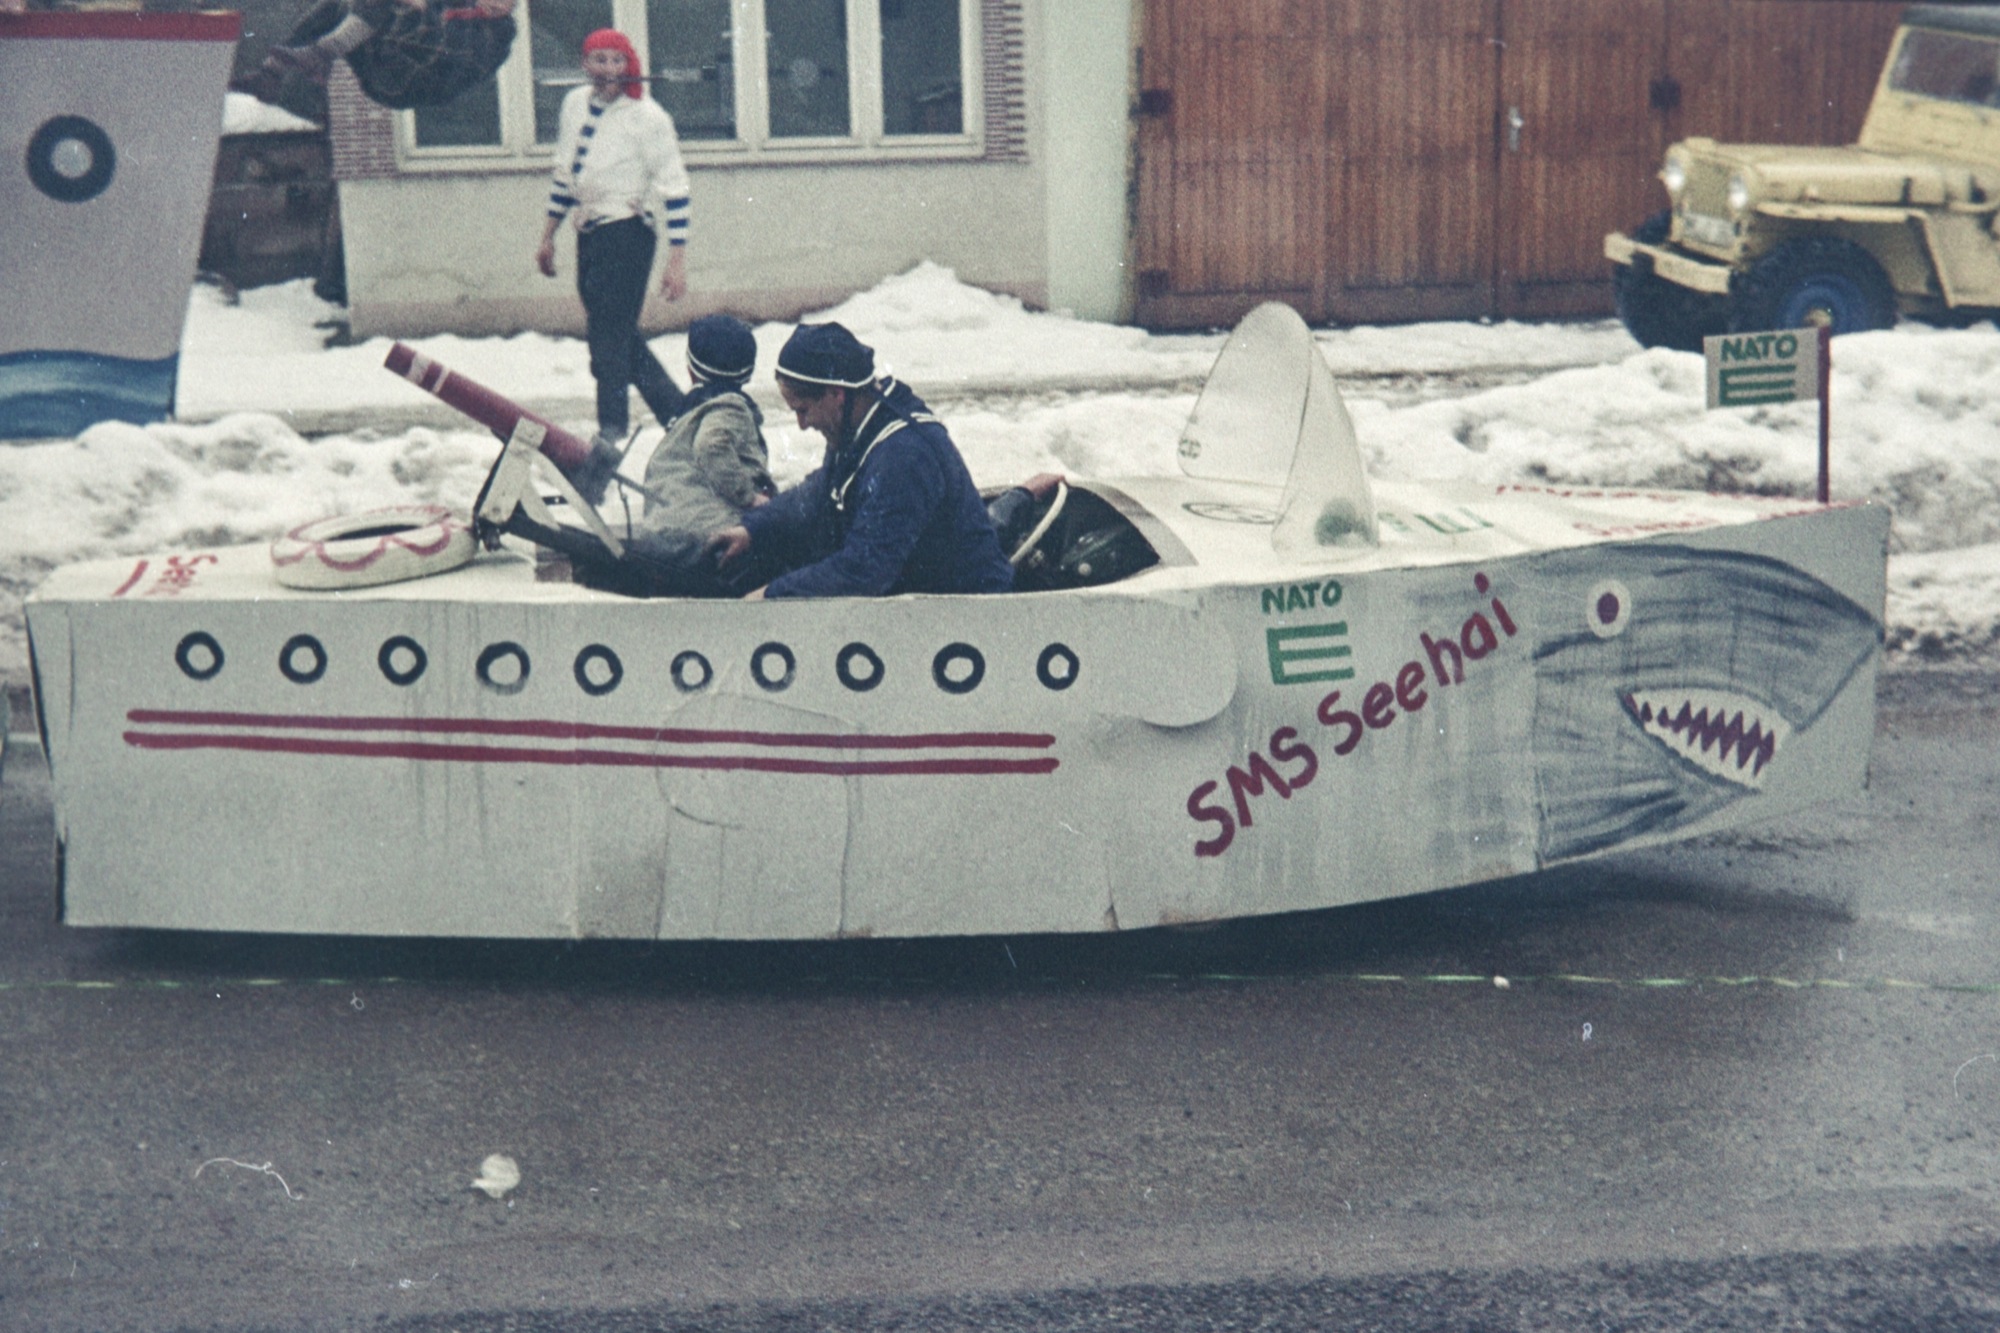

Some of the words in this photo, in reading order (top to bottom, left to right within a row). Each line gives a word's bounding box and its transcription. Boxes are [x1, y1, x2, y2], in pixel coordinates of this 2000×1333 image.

[1720, 334, 1798, 361] NATO
[1261, 580, 1343, 614] NATO
[1187, 725, 1318, 857] SMS
[1317, 571, 1518, 756] Seehai
